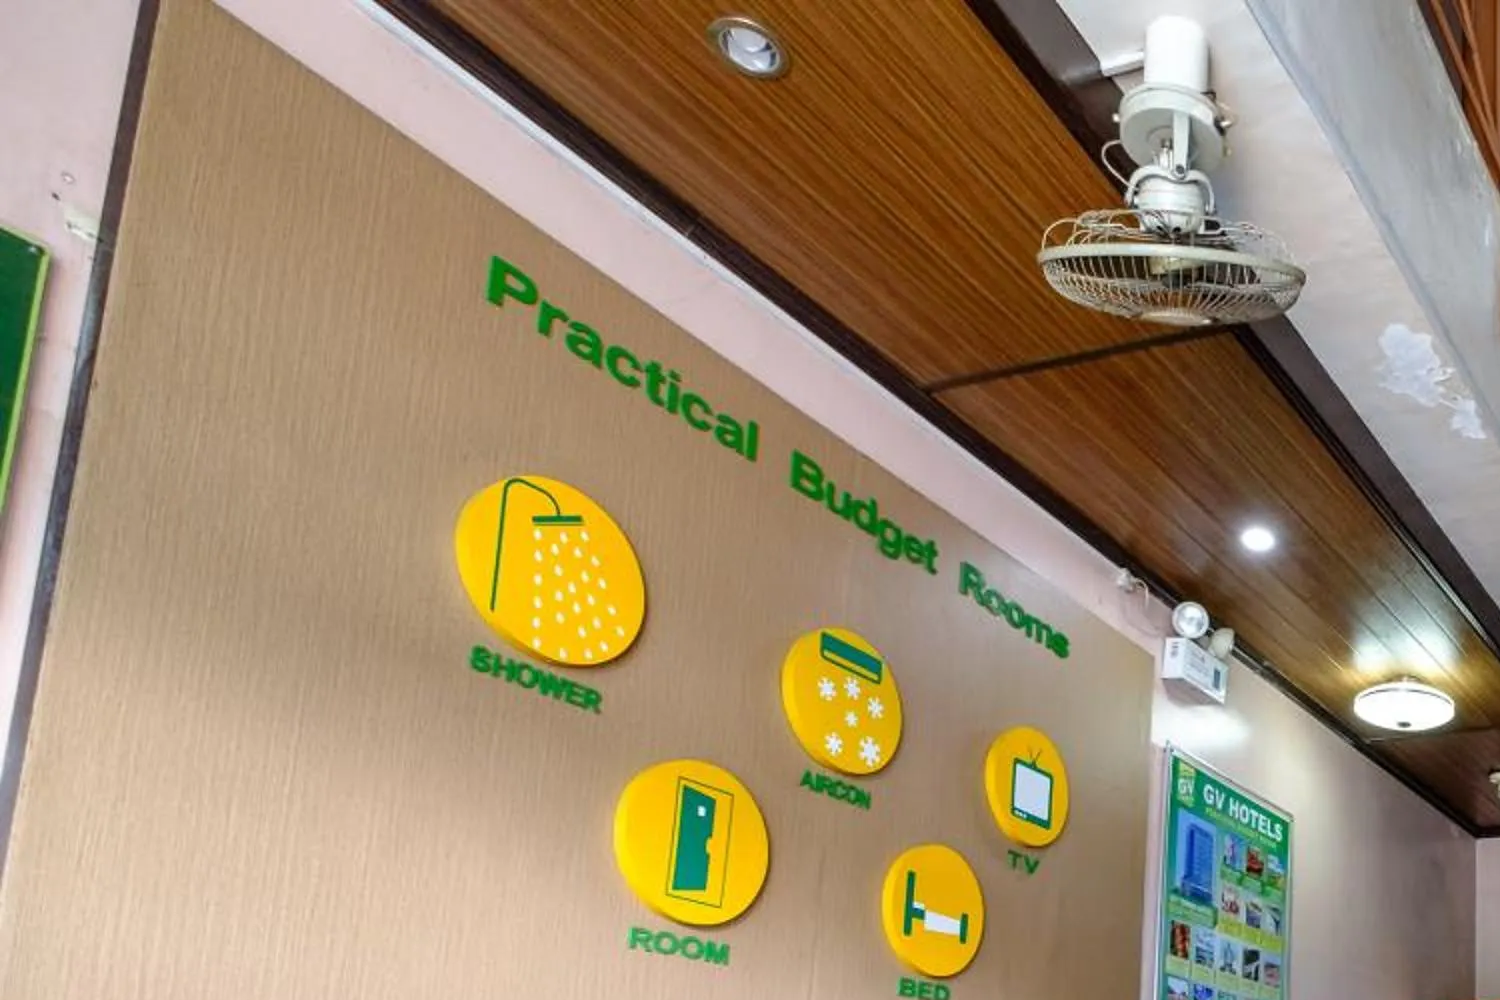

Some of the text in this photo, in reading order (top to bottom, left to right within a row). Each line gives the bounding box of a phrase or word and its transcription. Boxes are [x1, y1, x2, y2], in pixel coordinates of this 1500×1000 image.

[485, 254, 1071, 660] Practical Budget Rooms
[469, 645, 603, 714] SHOWER
[799, 769, 872, 811] AIRCON
[1203, 783, 1226, 811] GV
[1229, 797, 1284, 842] HOTELS
[1009, 849, 1040, 876] TV
[628, 928, 731, 967] ROOM
